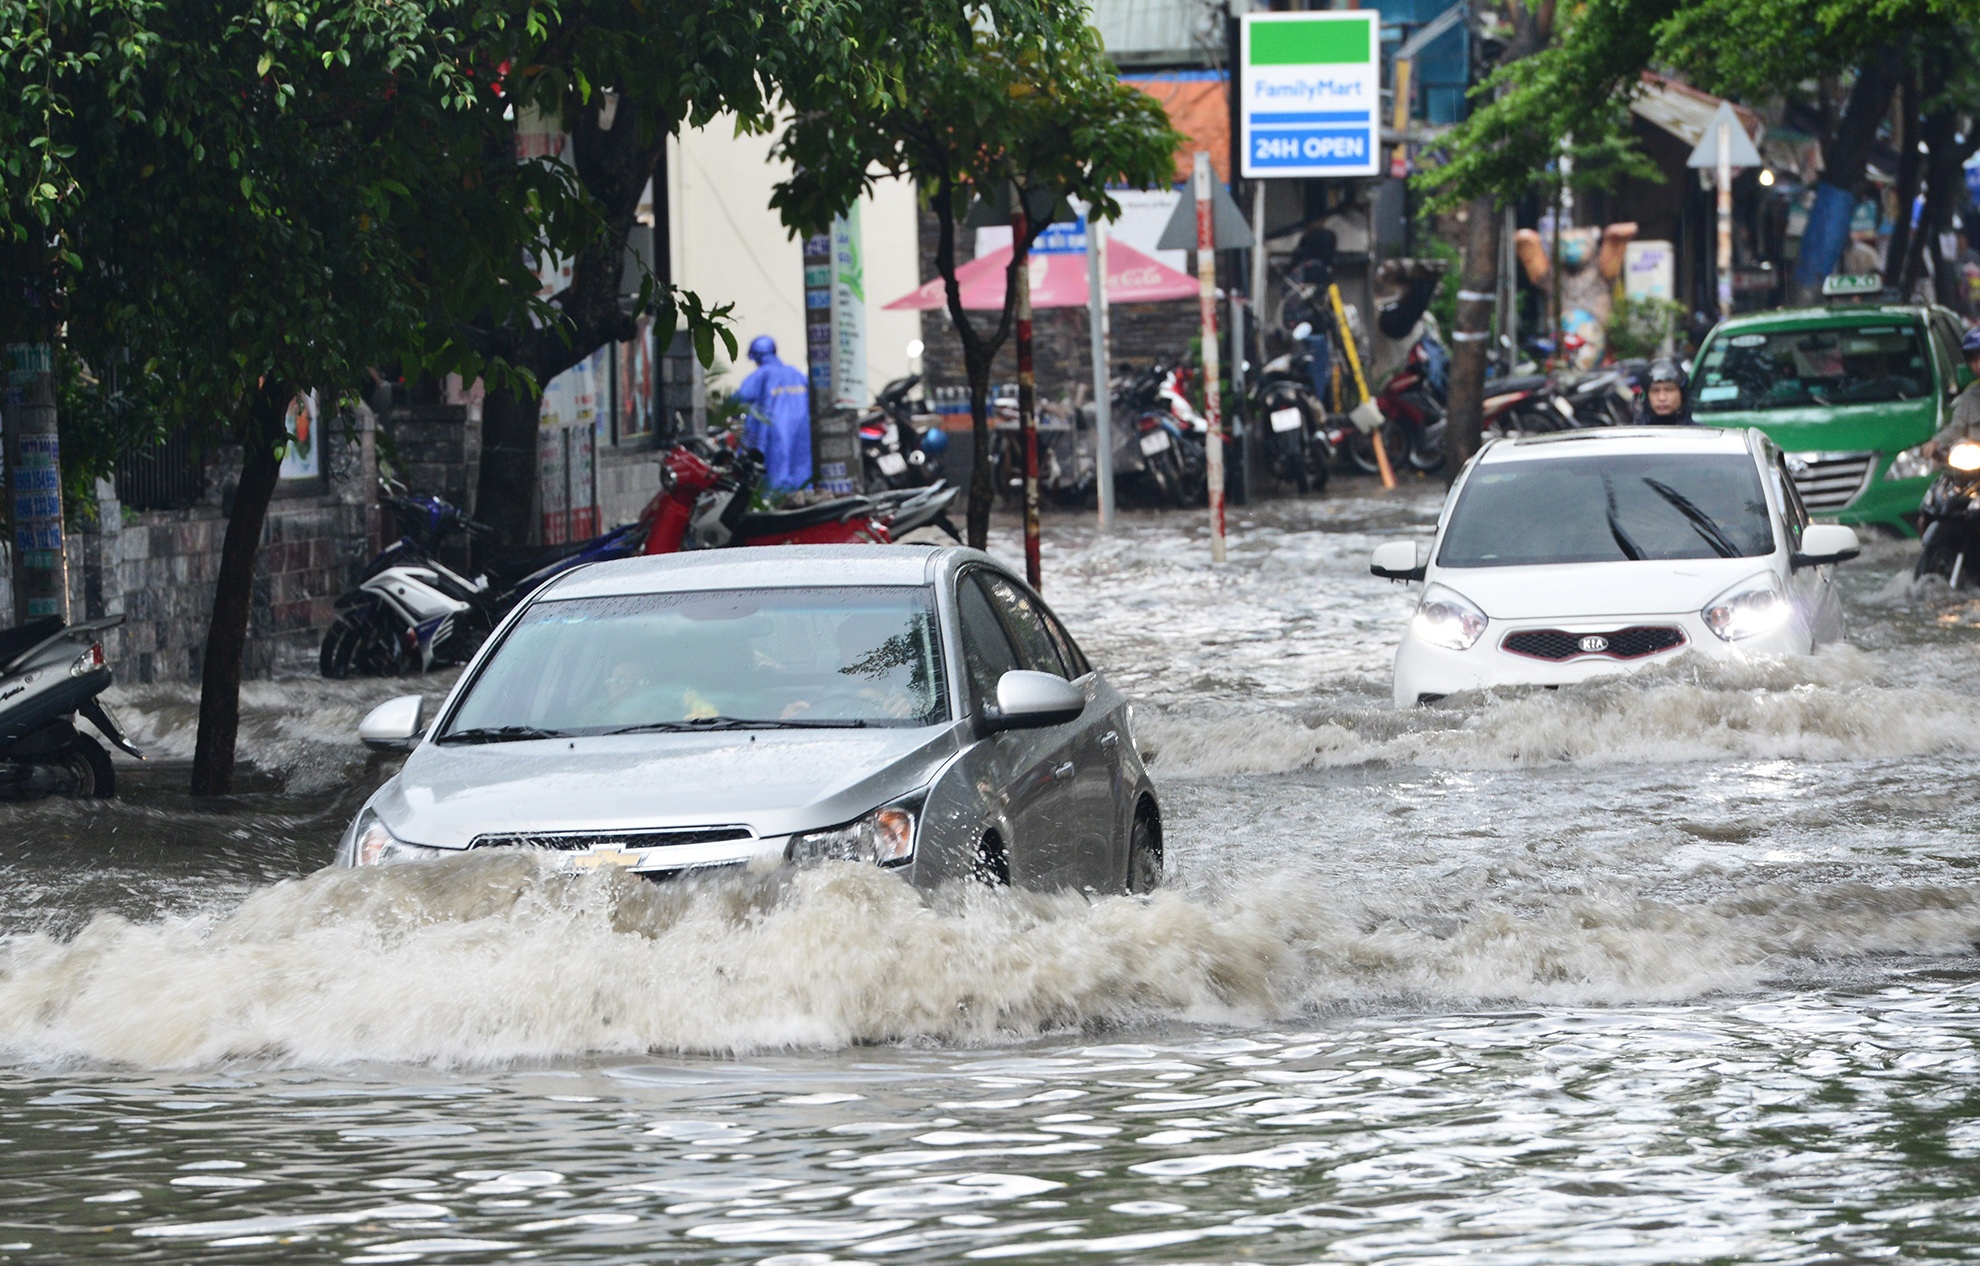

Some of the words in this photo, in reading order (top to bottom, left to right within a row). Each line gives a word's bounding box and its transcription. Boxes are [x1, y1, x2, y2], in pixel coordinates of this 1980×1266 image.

[1255, 79, 1362, 101] FamilyMart
[1255, 137, 1299, 159] 24H
[1303, 136, 1364, 158] OPEN
[1829, 275, 1877, 289] TAXI
[1583, 638, 1604, 649] KIA
